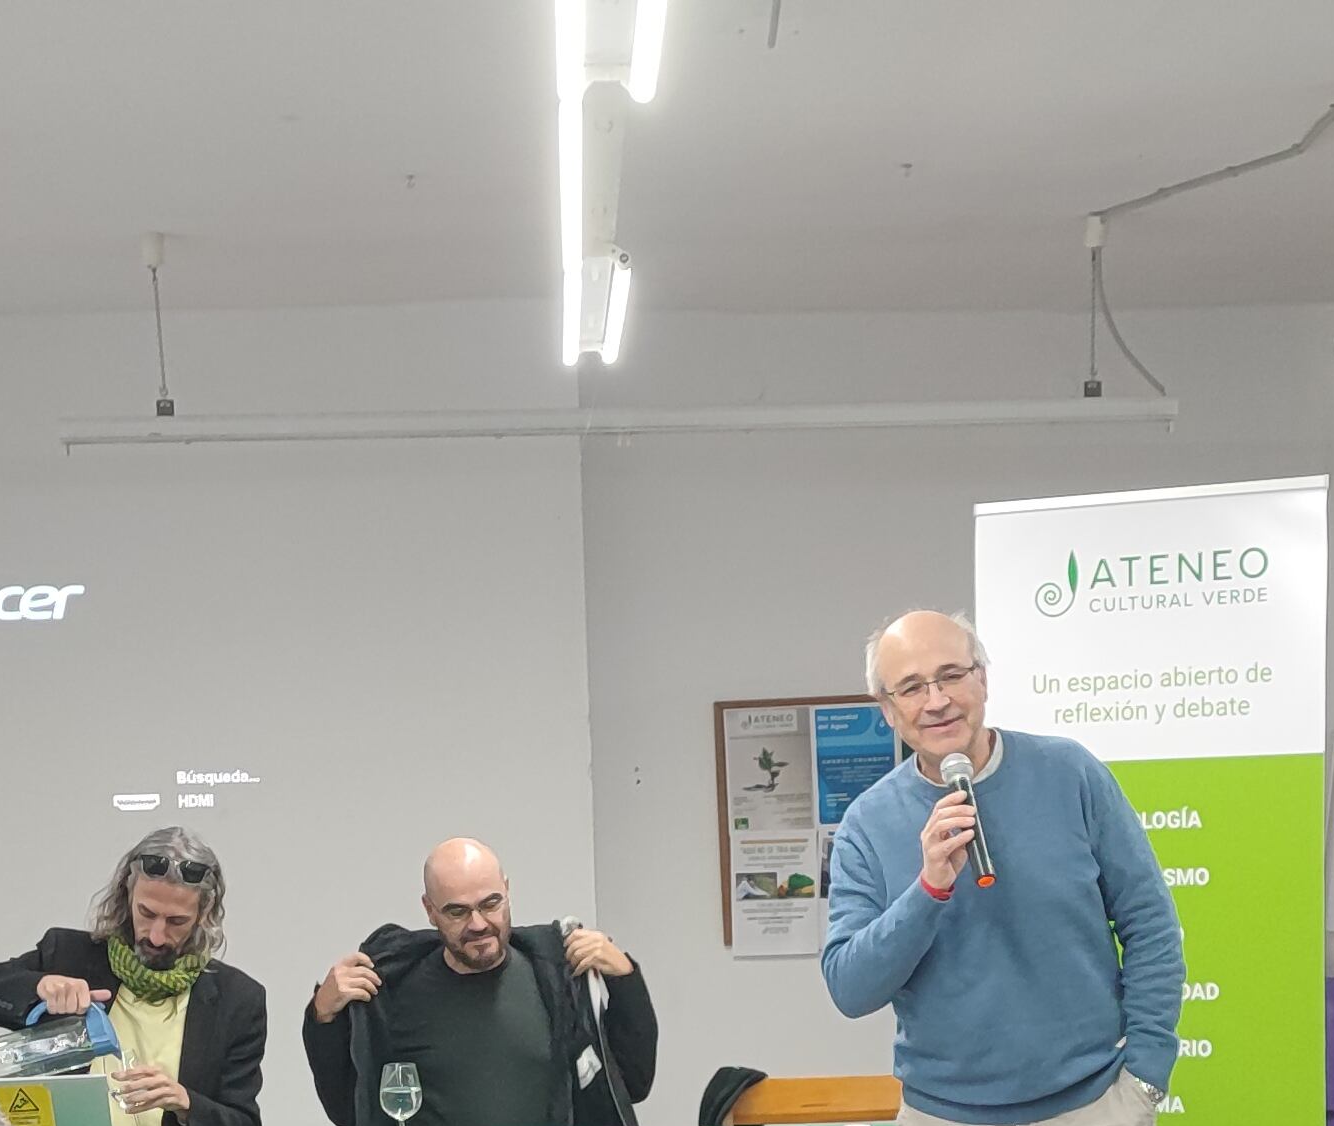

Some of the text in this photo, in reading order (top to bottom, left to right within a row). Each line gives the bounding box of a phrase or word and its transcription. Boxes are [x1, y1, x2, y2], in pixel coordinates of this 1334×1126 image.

[1089, 546, 1269, 590] ATENEO
[1089, 587, 1268, 613] CULTURAL VERDE
[1032, 662, 1273, 696] Un espacio abierto de
[1054, 696, 1251, 725] reflexión y debate
[178, 793, 215, 809] HDMI
[1141, 806, 1203, 830] LOGÍA
[1163, 867, 1210, 887] SMO
[1181, 982, 1220, 1001] DAD
[1178, 1039, 1213, 1058] RIO
